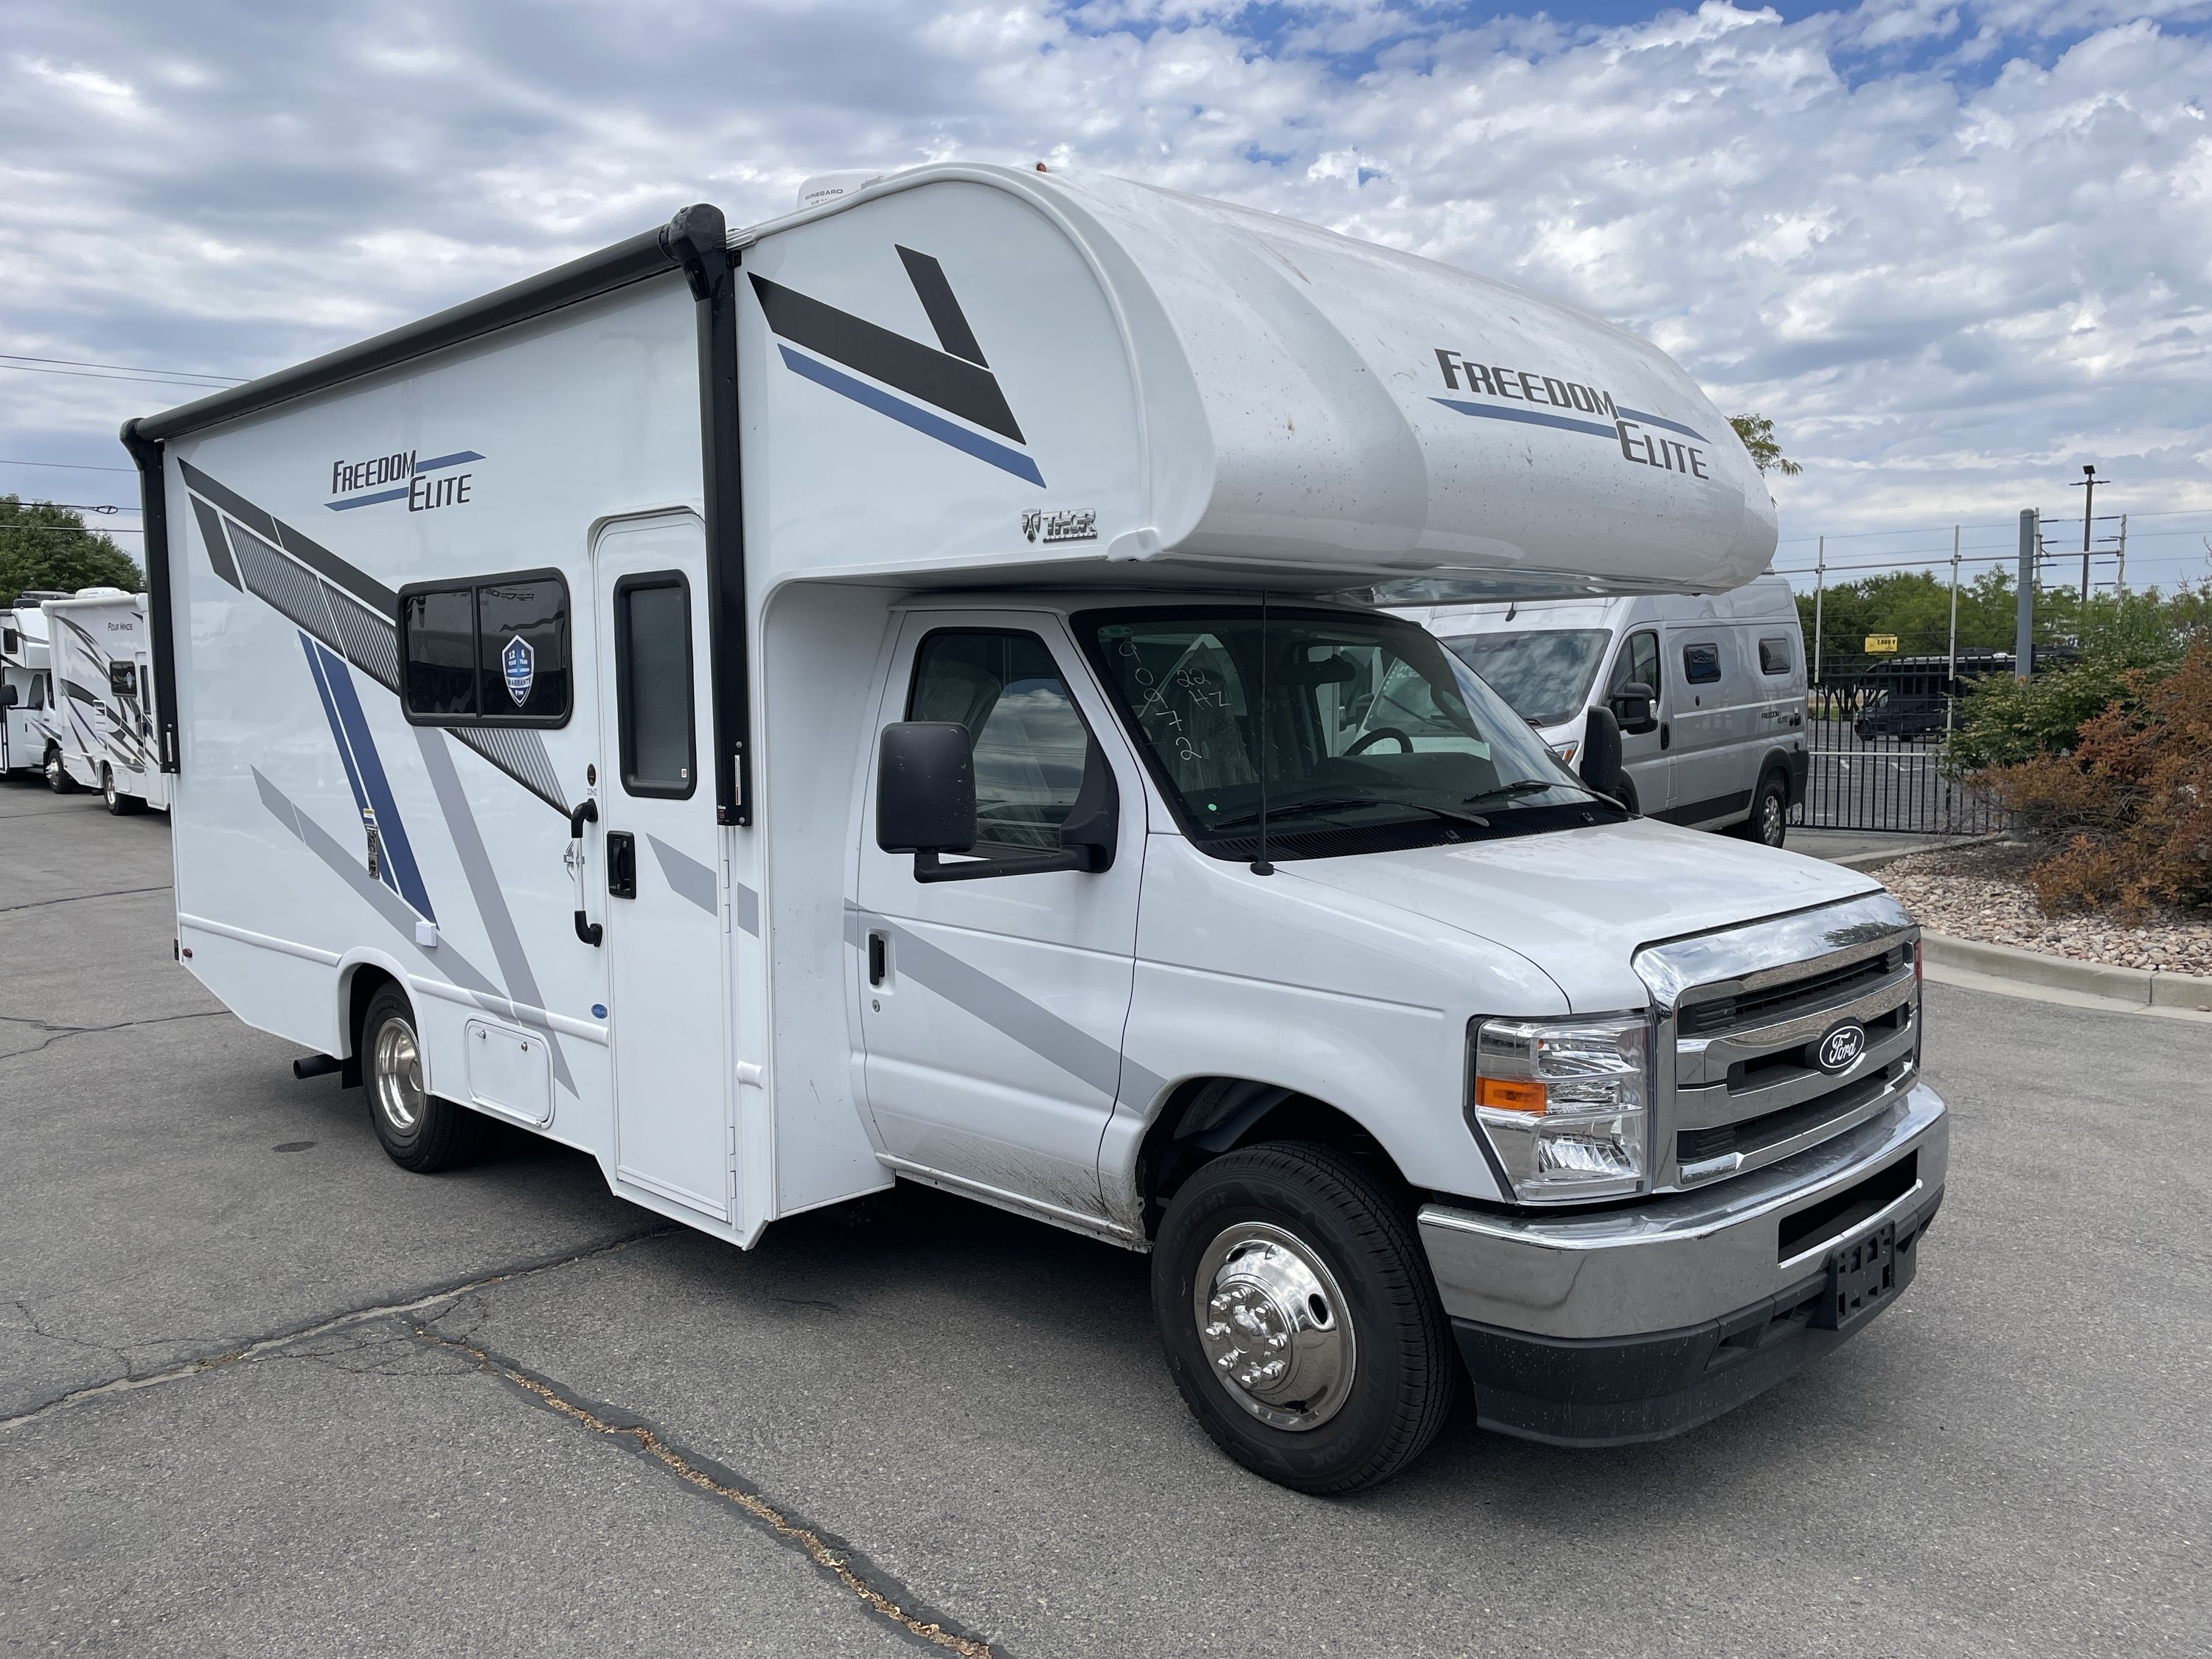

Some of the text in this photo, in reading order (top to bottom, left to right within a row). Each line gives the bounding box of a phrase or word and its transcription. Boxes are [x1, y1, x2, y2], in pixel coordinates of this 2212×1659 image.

[804, 189, 844, 201] WINEGARD
[1434, 348, 1619, 420] FREEDOM
[1616, 420, 1709, 480] ELITE
[332, 450, 416, 494] FREEDOM
[408, 474, 472, 512] ELITE
[1043, 508, 1097, 535] THOR
[508, 650, 515, 659] 12
[521, 649, 525, 658] 6
[1177, 667, 1211, 687] 22
[1829, 1032, 1857, 1063] Ford
